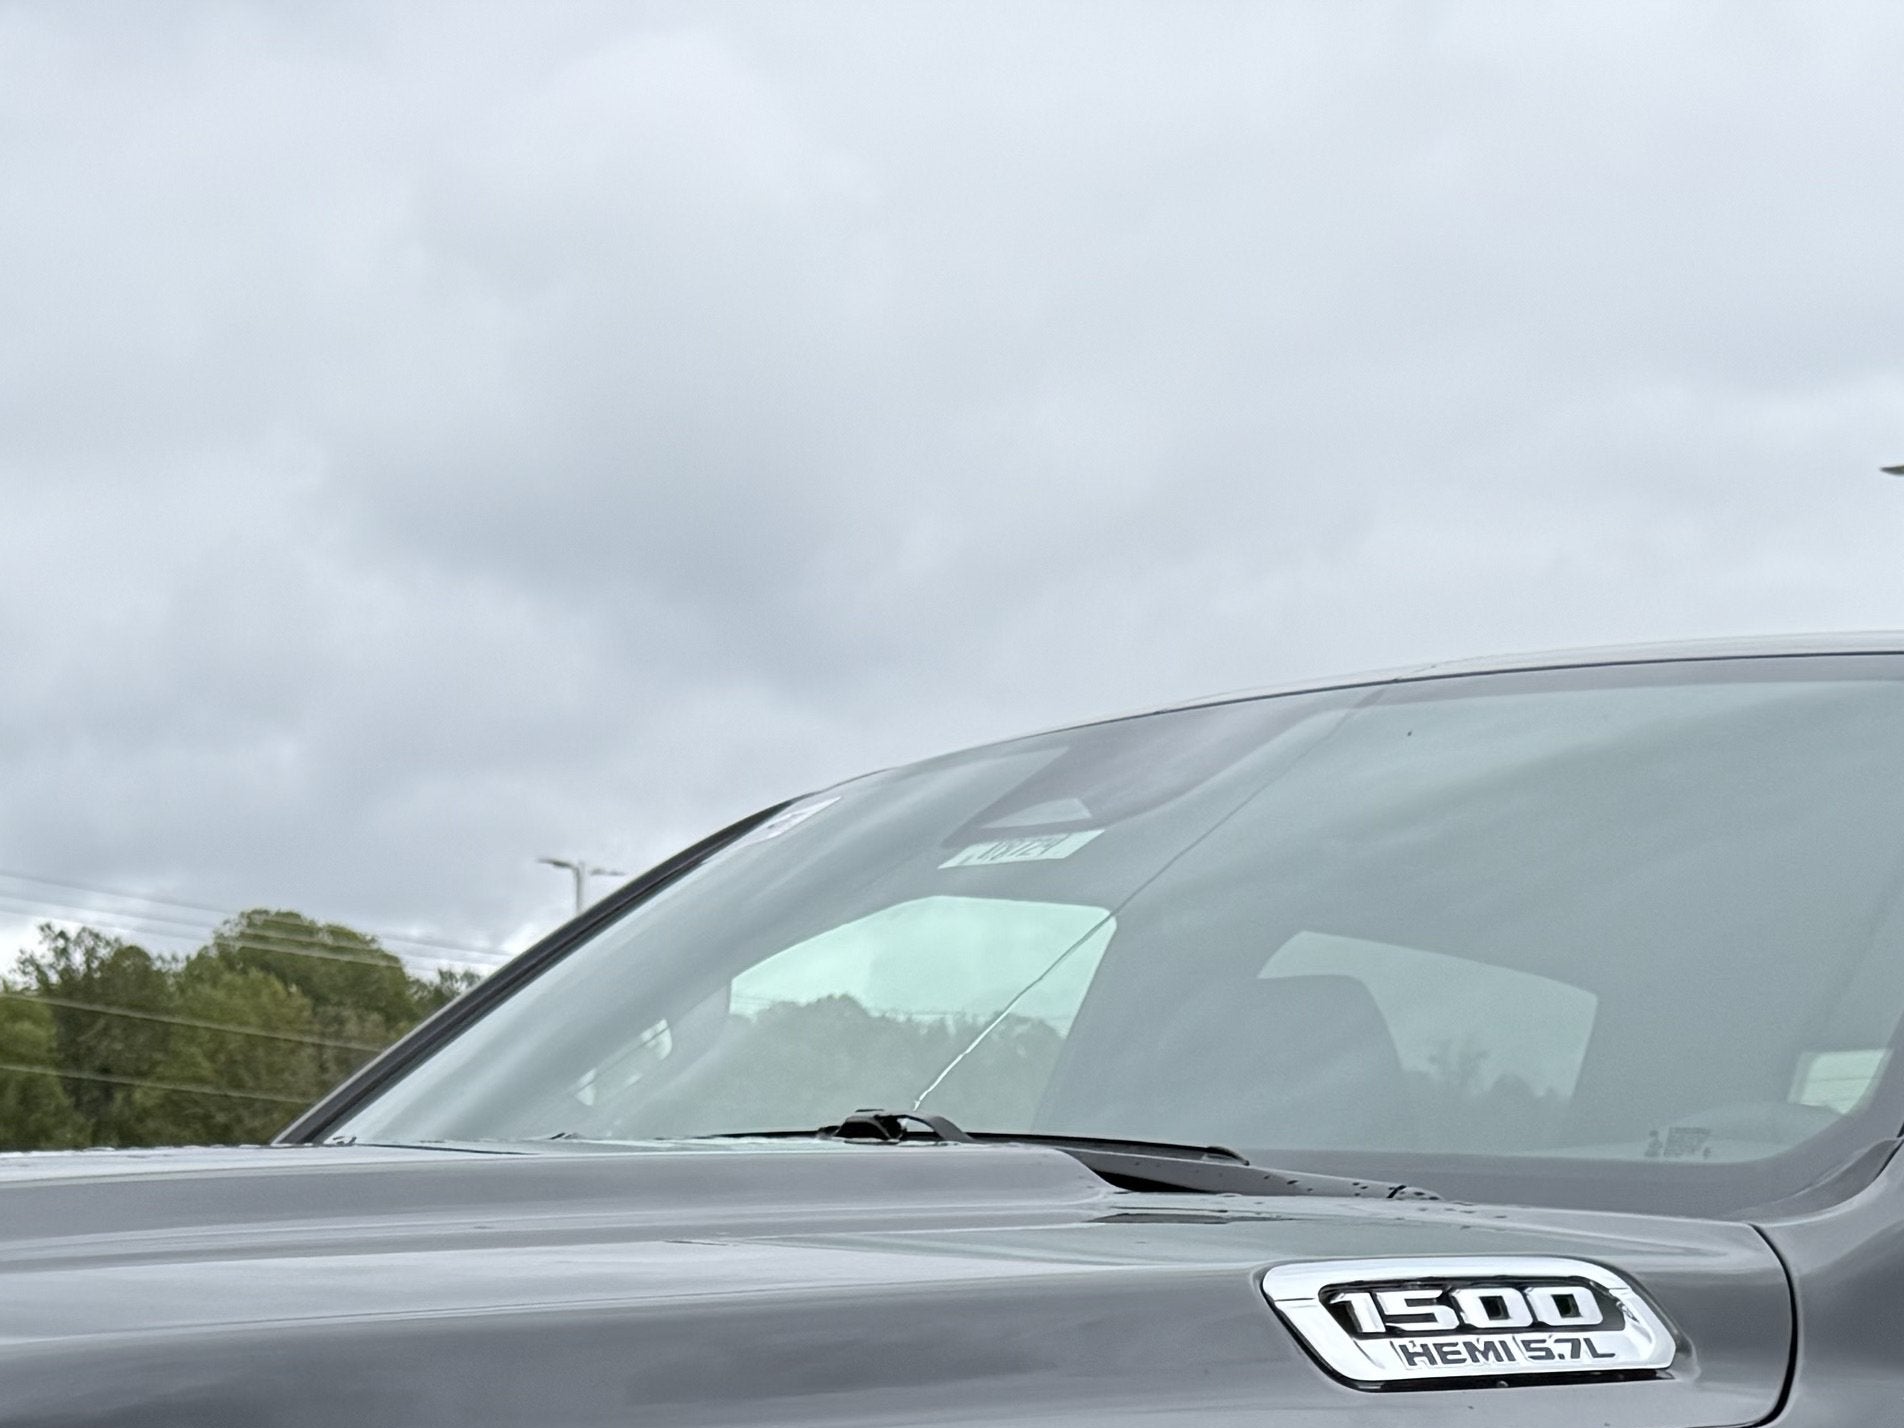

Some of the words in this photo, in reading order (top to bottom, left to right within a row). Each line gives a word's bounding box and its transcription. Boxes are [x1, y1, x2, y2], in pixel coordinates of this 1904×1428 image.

[1330, 1286, 1604, 1333] 1500
[1399, 1339, 1514, 1367] HEMI
[1524, 1338, 1616, 1361] 5.7L
